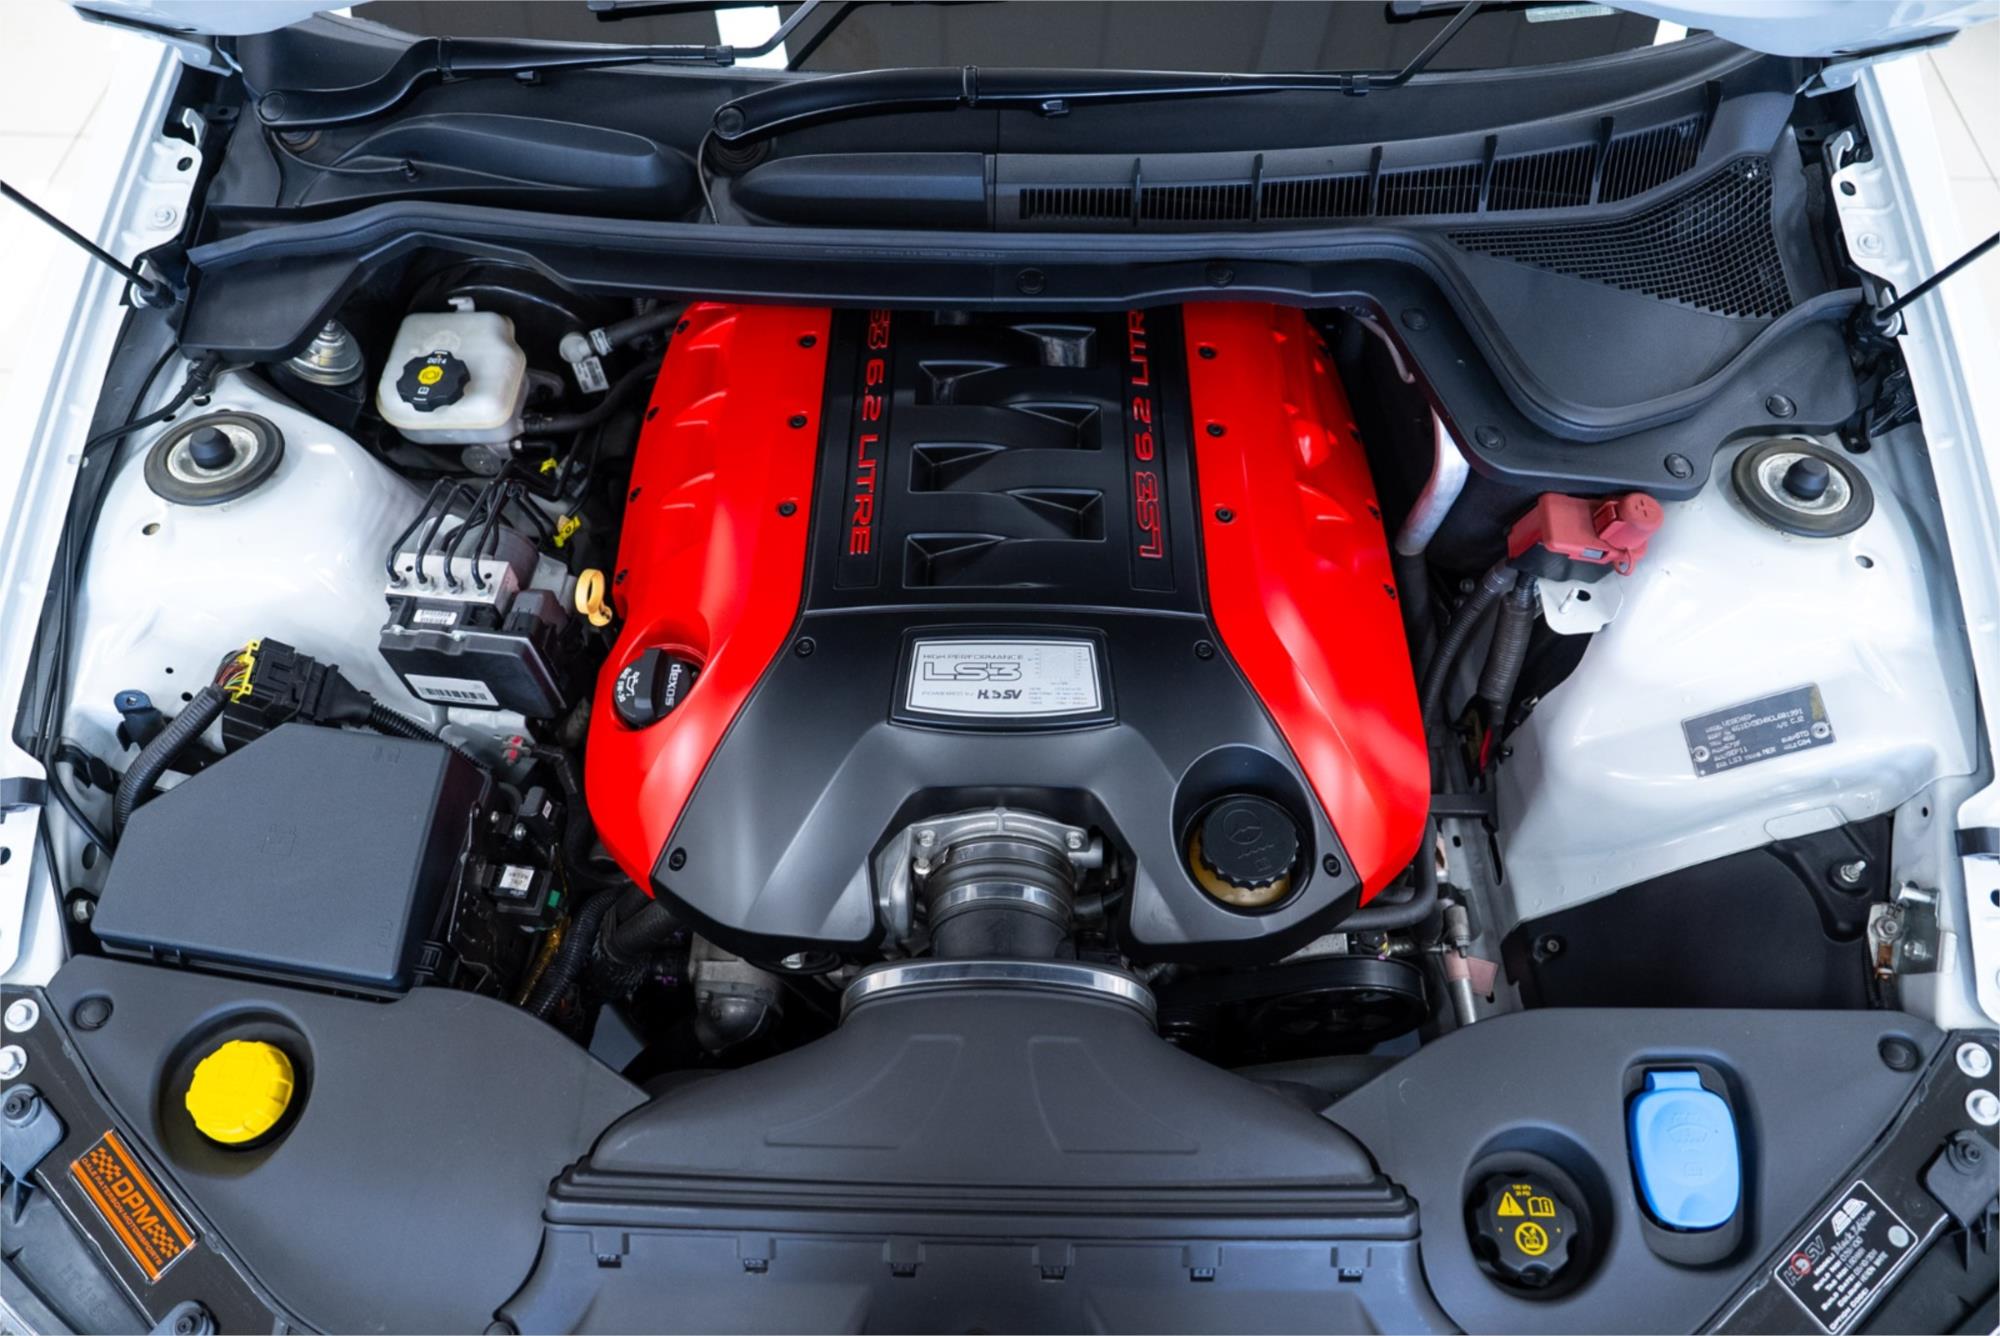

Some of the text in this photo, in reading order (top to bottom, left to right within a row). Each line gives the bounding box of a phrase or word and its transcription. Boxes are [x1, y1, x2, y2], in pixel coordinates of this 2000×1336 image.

[862, 358, 884, 421] 6.2
[1128, 310, 1162, 558] LS3 6.2 LITR
[851, 434, 878, 554] LITRE
[665, 664, 682, 706] dexos
[923, 662, 1022, 681] LS3
[82, 1158, 98, 1177] DALE
[123, 1213, 162, 1264] MOTORSPORTS
[112, 1177, 158, 1231] DPM
